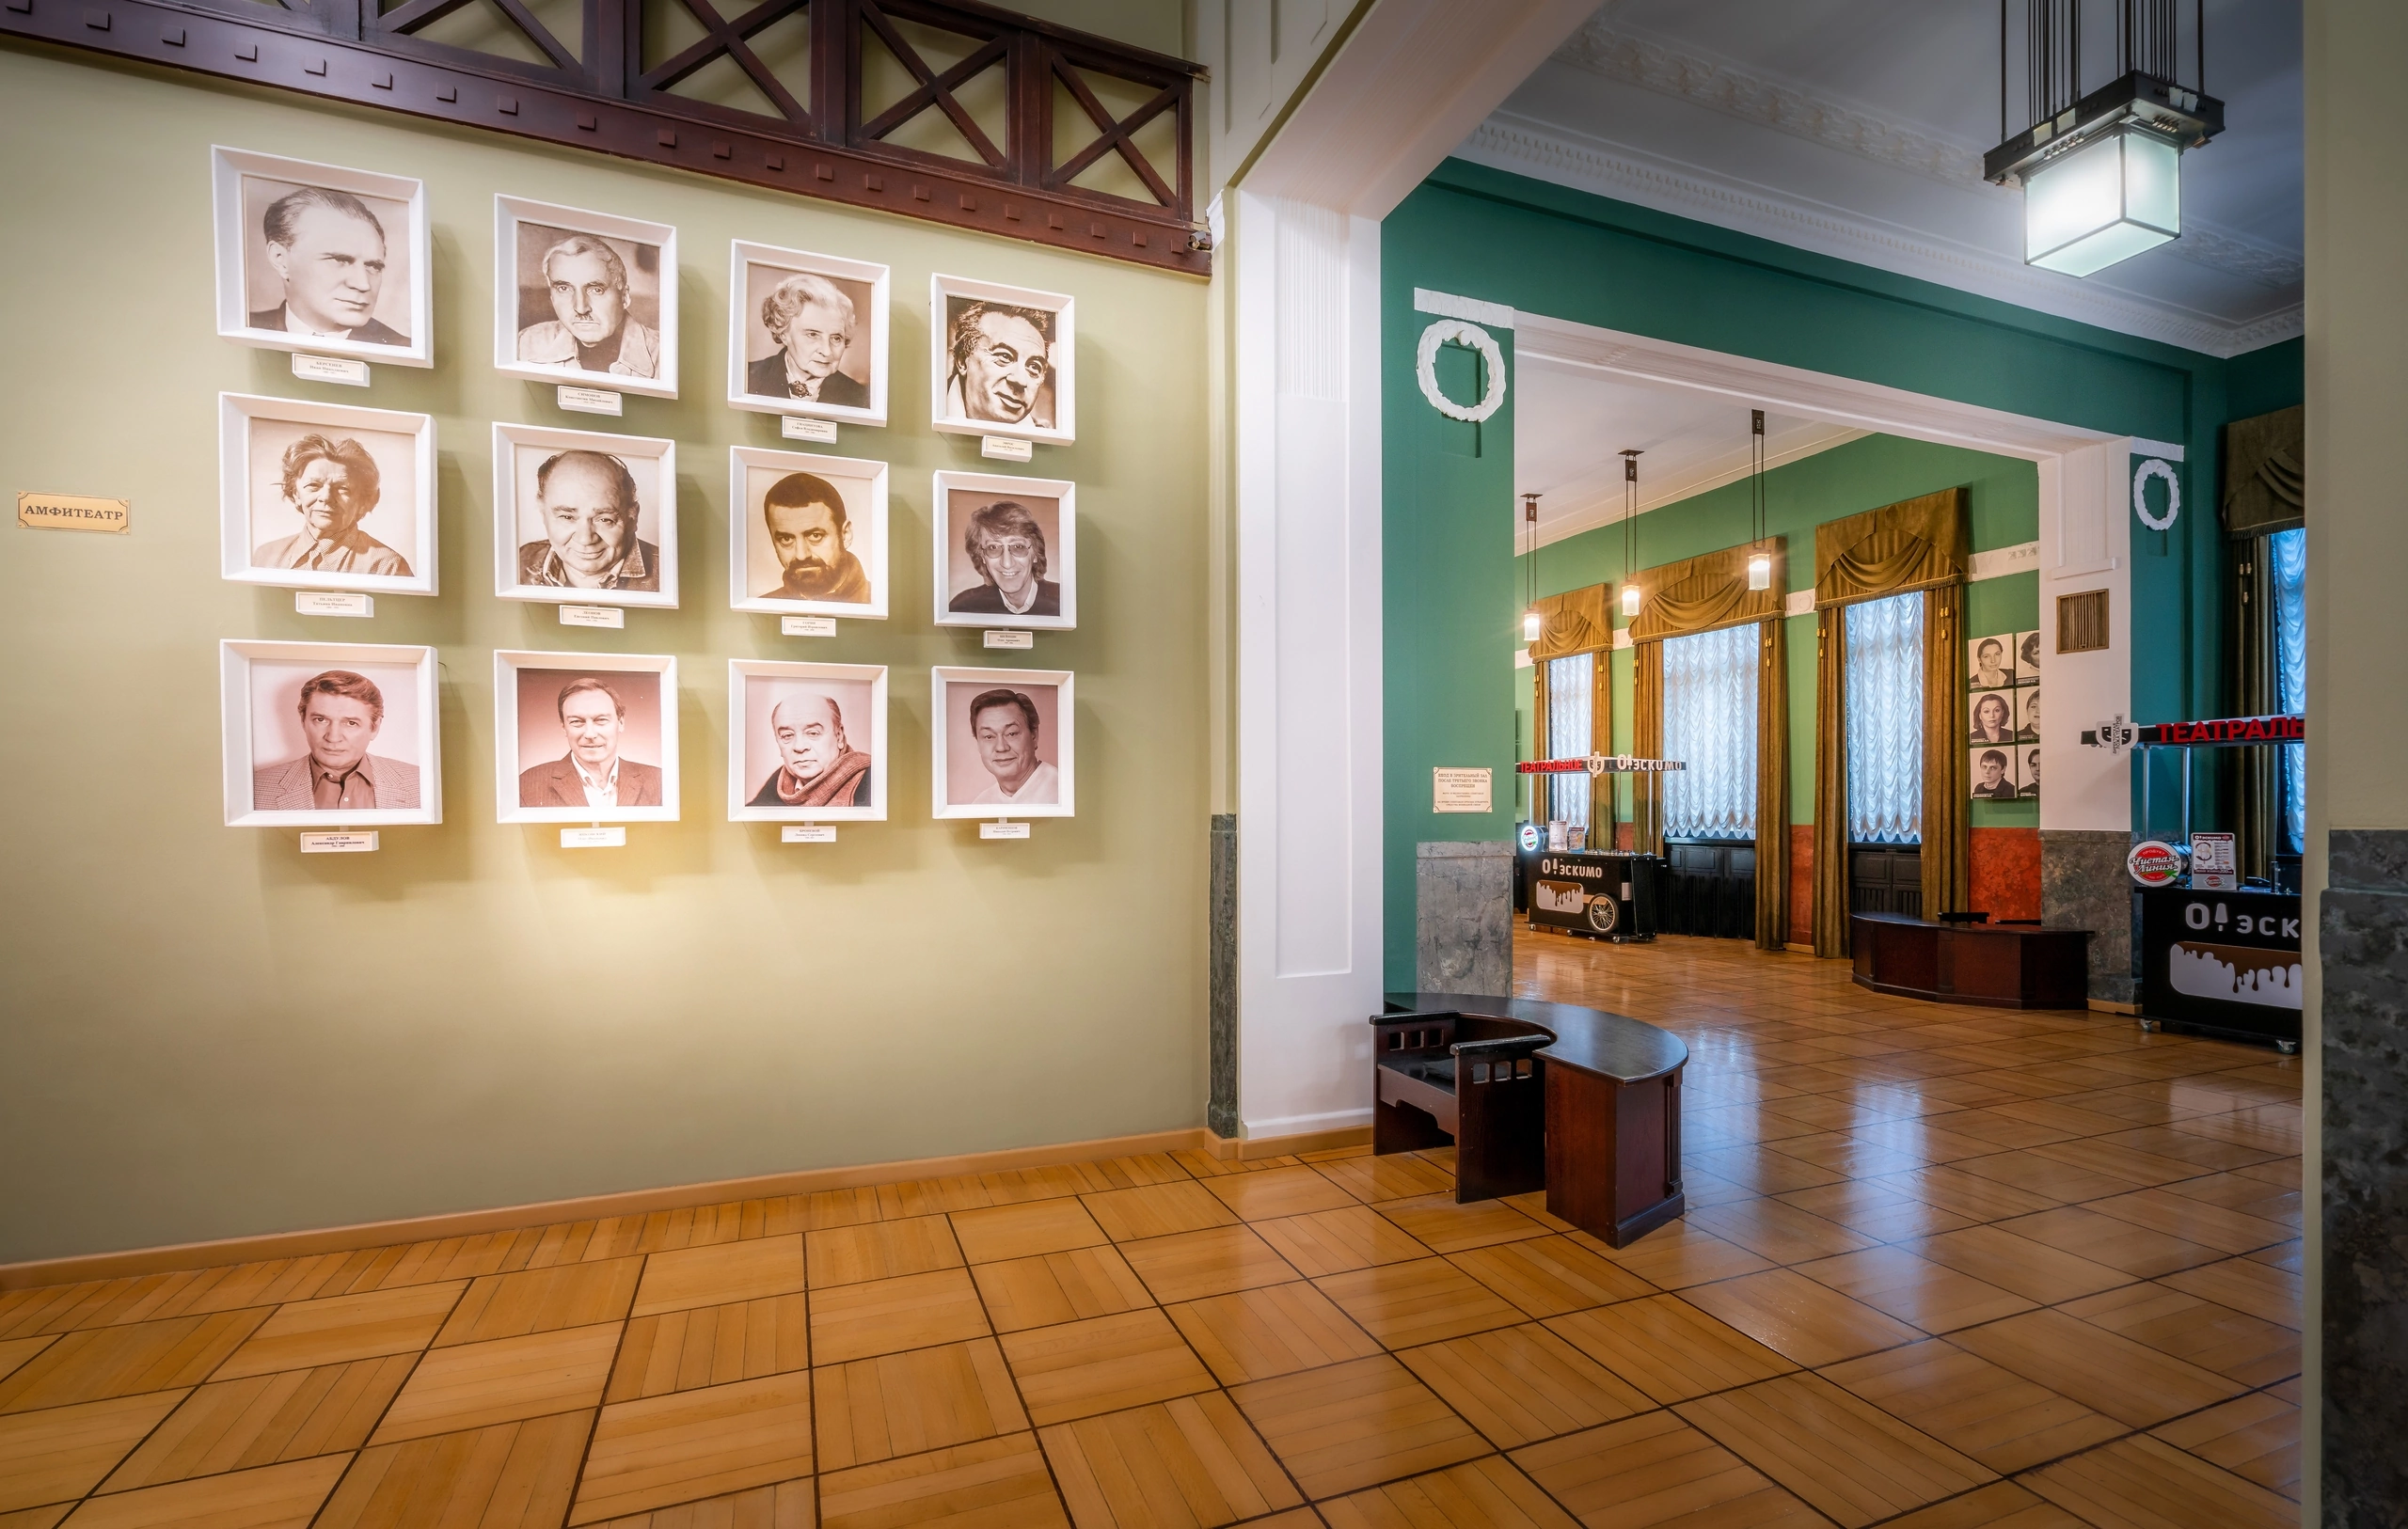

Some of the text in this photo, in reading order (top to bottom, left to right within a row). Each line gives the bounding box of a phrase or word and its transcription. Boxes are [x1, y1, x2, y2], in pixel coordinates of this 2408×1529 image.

[24, 505, 123, 520] АМФИТЕАТР
[1520, 759, 1583, 773] ТЕАТРАЛЬНОЕ
[2129, 856, 2180, 864] Чистая
[2134, 864, 2178, 875] Линия
